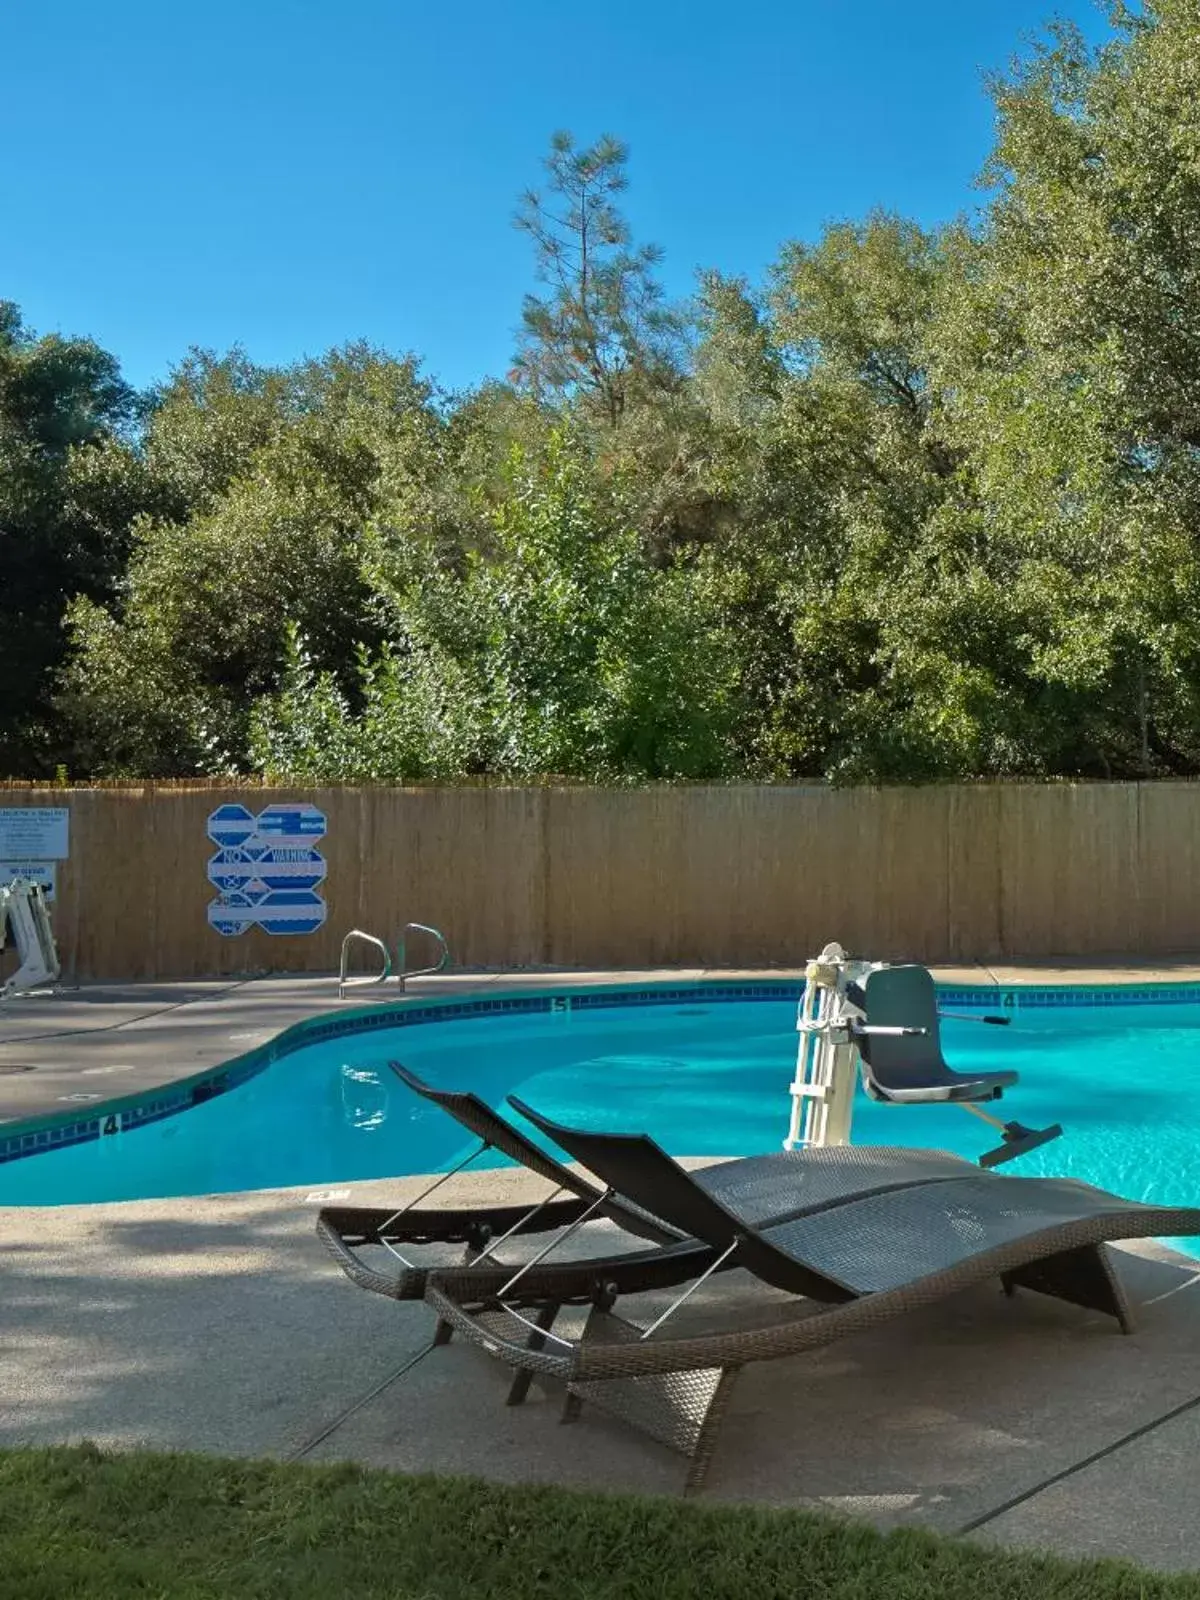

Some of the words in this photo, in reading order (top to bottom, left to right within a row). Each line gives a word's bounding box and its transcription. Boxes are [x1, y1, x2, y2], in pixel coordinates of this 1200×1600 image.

[223, 848, 241, 863] NO
[554, 996, 567, 1012] 5
[1003, 992, 1015, 1007] 4
[103, 1114, 119, 1135] 4
